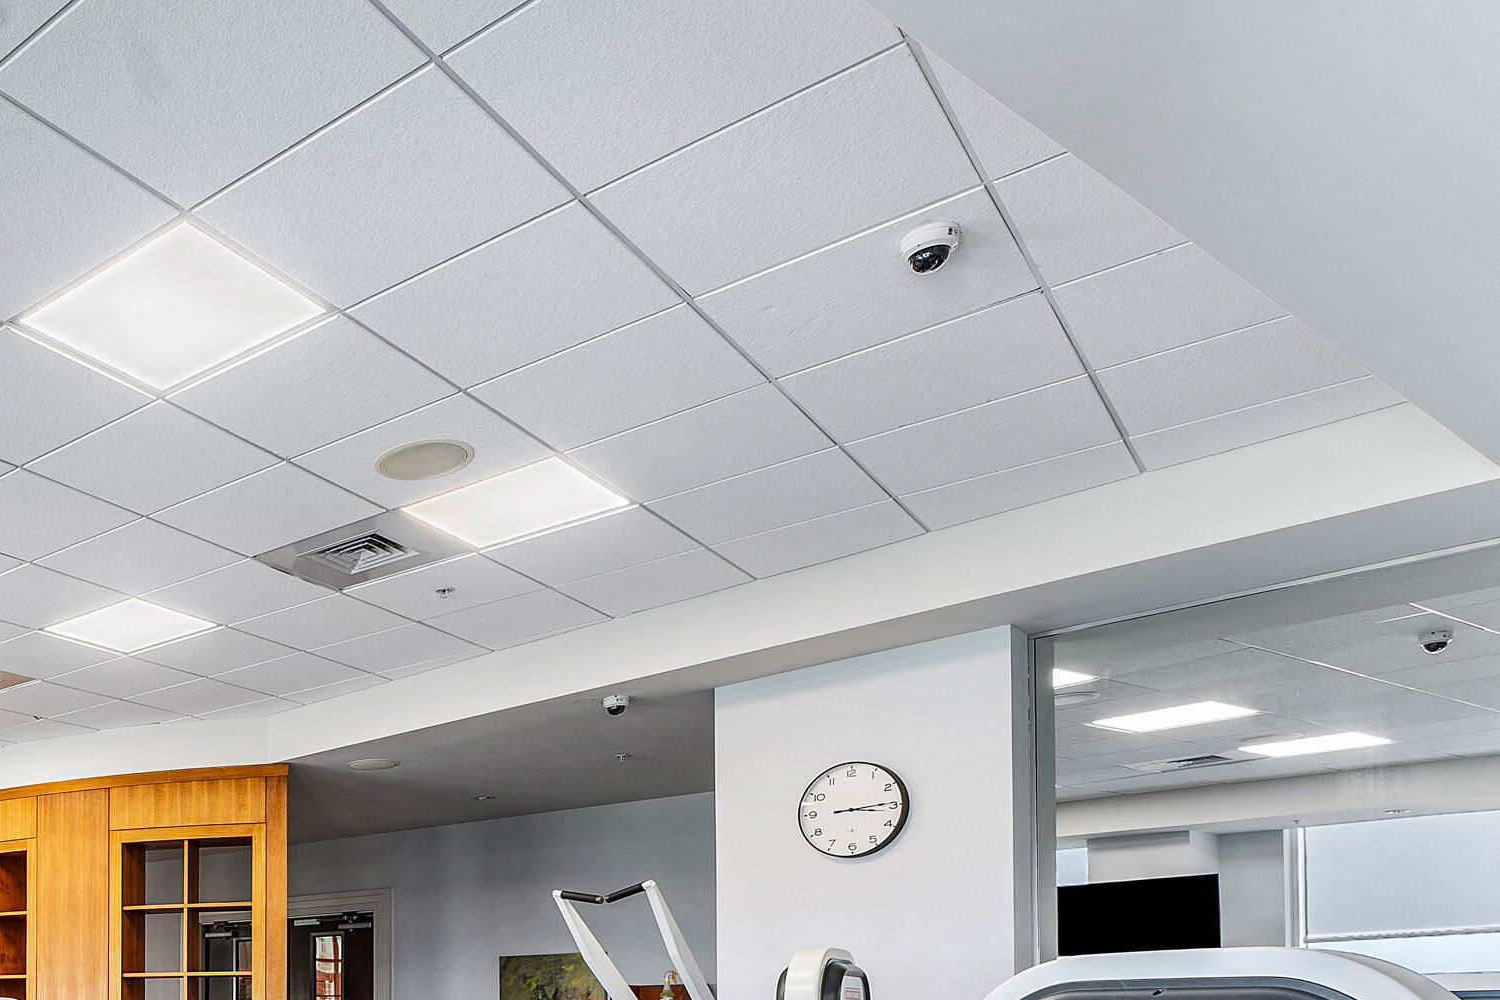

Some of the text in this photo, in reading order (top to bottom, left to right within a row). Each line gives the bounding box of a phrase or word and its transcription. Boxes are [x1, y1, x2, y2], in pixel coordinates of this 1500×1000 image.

[846, 769, 857, 778] 12
[829, 778, 835, 786] 11
[884, 783, 892, 791] 2
[813, 793, 826, 802] 10
[888, 801, 898, 809] 3
[808, 811, 818, 819] 9
[814, 828, 822, 836] 8
[828, 839, 837, 848] 7
[869, 835, 878, 844] 5
[848, 842, 857, 851] 6
